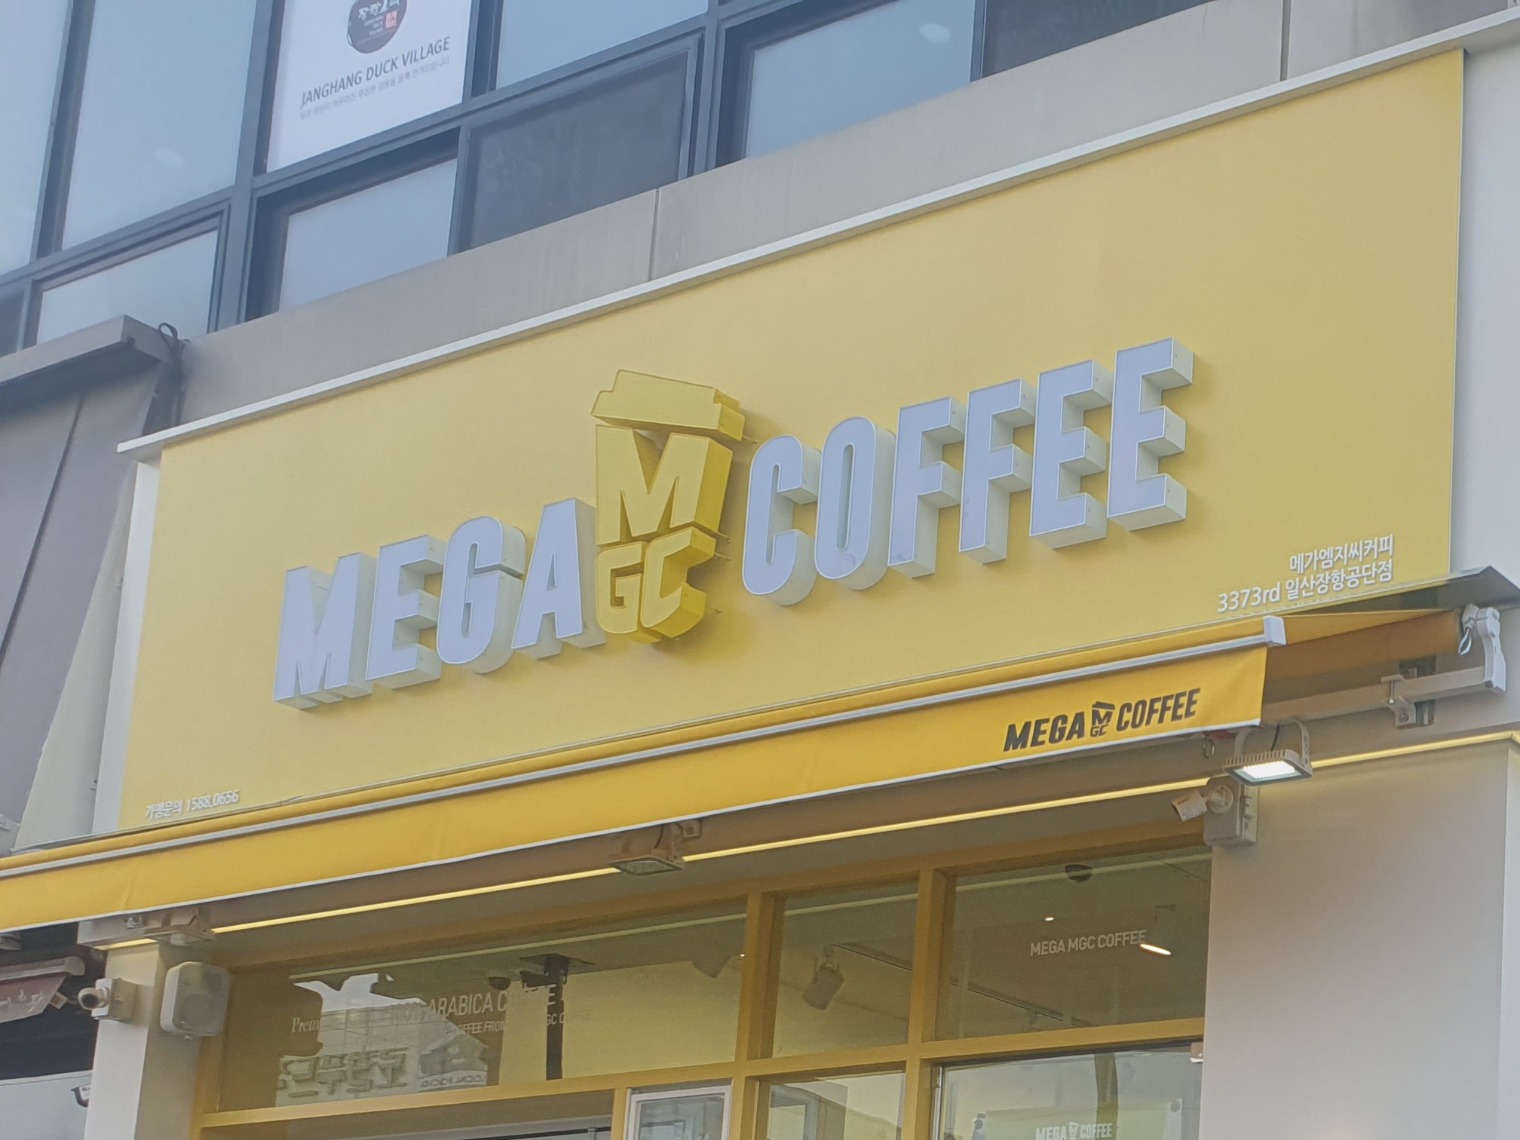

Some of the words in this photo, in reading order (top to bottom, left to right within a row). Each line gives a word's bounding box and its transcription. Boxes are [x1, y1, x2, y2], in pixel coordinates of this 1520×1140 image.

[300, 70, 362, 109] JANGHANG
[365, 56, 398, 81] DUCK
[401, 36, 450, 67] VILLAGE
[273, 497, 597, 709] MEGA
[741, 337, 1194, 606] COFFEE
[1289, 534, 1393, 574] 메가엠지씨커피
[1217, 582, 1281, 613] 3373rd
[1285, 559, 1392, 600] 일산장항공단점
[1003, 712, 1085, 752] MEGA
[1116, 688, 1200, 732] COFFEE
[1030, 938, 1066, 957] MEGA
[1068, 935, 1095, 951] MGC
[1097, 929, 1147, 949] COFFEE
[427, 991, 494, 1017] ARABICA
[1080, 1122, 1113, 1139] COFFEE
